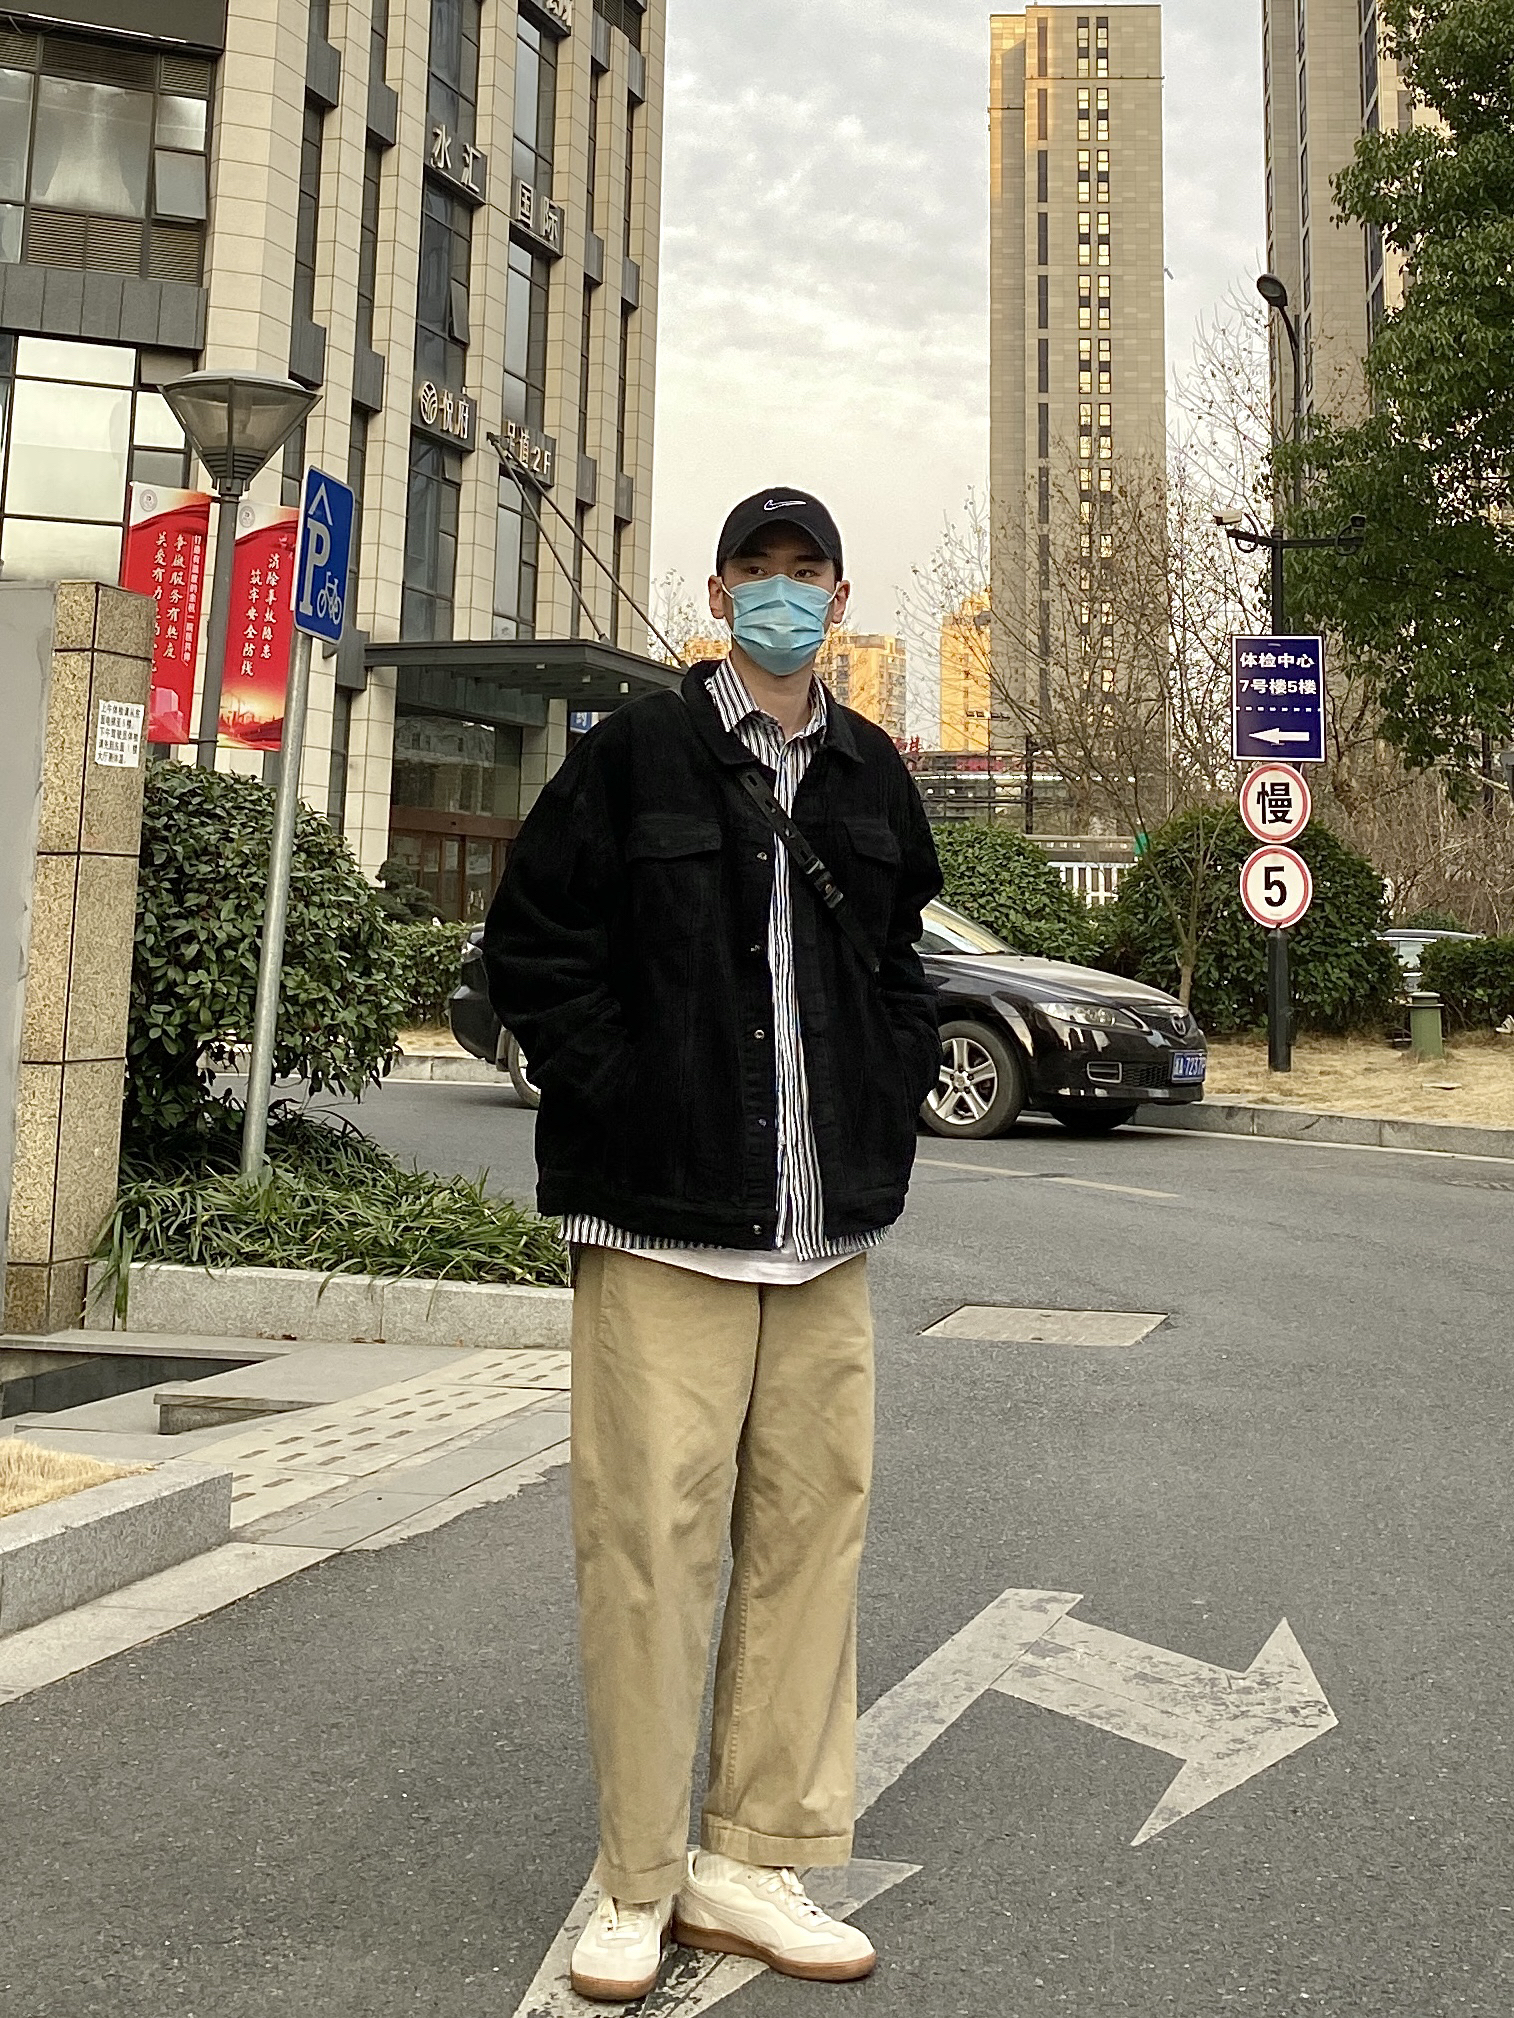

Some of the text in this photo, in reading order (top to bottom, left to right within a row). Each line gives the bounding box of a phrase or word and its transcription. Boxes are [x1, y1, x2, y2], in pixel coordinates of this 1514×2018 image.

[430, 124, 559, 241] 水汇 国际
[299, 517, 331, 617] P
[240, 568, 263, 677] 筑牢安全防线
[260, 552, 280, 659] 消除事故隐患
[1239, 652, 1315, 669] 体检中心
[1239, 678, 1317, 695] 7号楼5楼
[1257, 781, 1293, 825] 慢
[1264, 866, 1287, 907] 5
